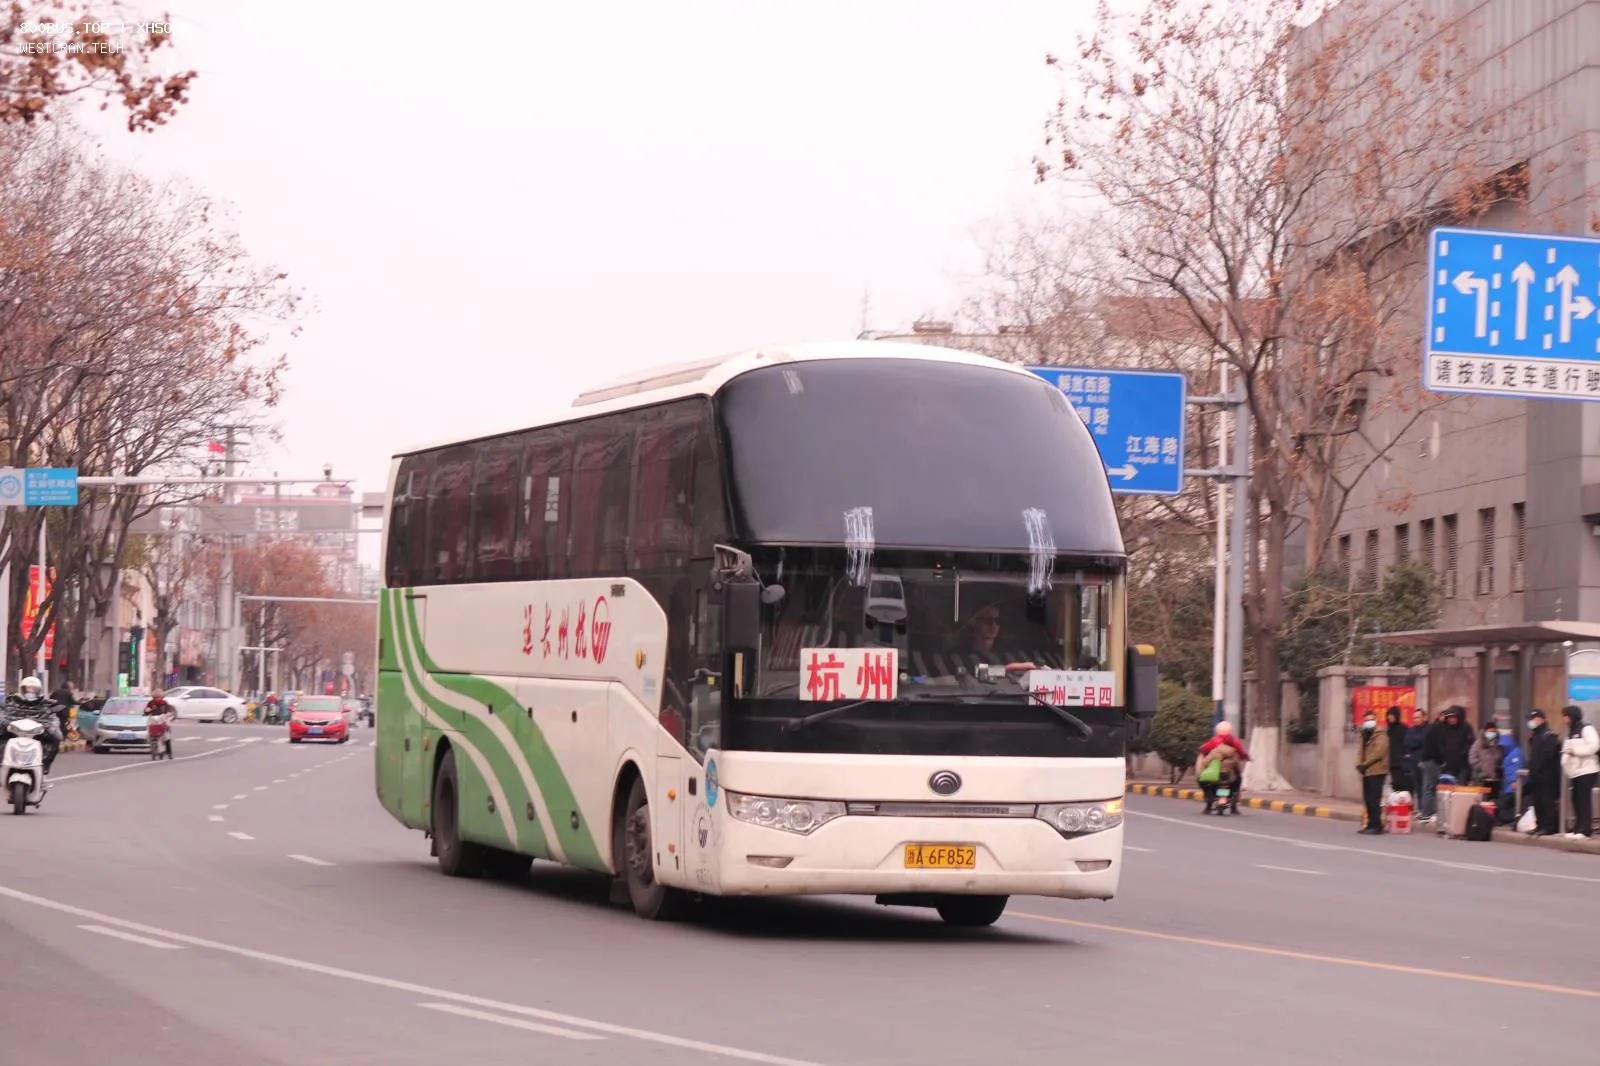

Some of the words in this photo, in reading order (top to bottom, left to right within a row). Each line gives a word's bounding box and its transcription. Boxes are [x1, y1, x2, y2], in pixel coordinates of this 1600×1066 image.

[1436, 359, 1600, 392] 请按规定车道行驶
[1126, 435, 1178, 456] 江海路
[806, 652, 893, 701] 杭州
